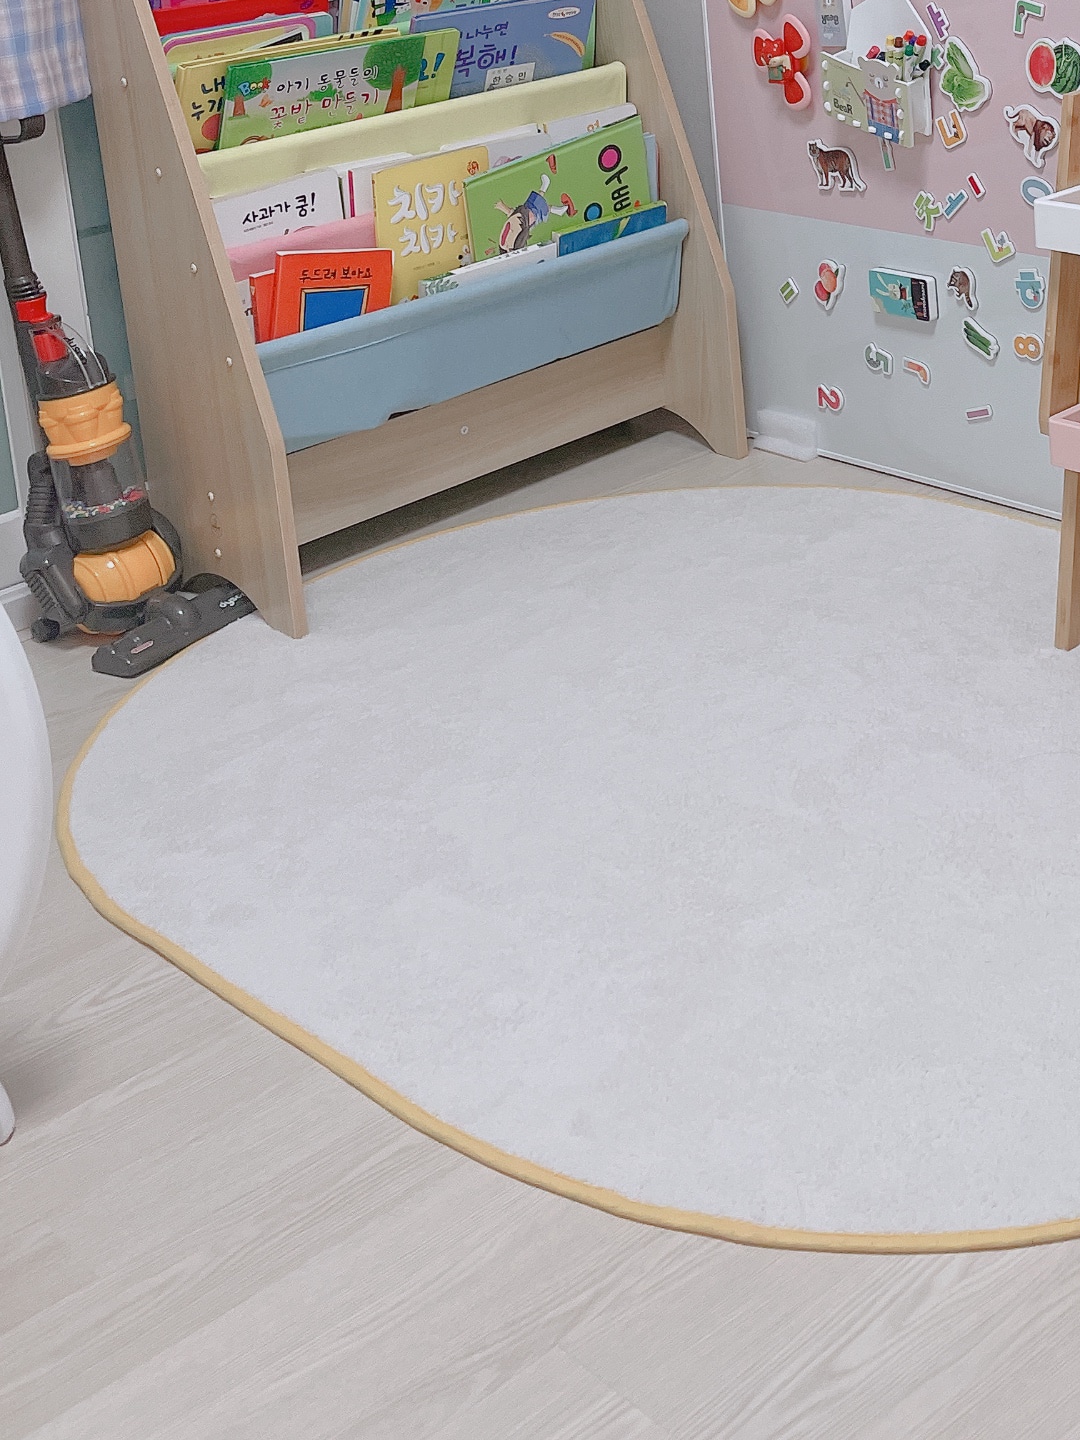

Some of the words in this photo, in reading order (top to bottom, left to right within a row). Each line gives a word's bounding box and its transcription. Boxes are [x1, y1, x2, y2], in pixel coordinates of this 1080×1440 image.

[277, 77, 309, 93] 아기
[318, 65, 379, 91] 동물들의
[270, 100, 312, 128] 꽃밭
[322, 88, 379, 117] 만들기
[242, 201, 291, 225] 사과가
[295, 192, 316, 218] 쿵!
[387, 180, 463, 224] 치카
[399, 223, 459, 257] 치카
[299, 268, 337, 283] 두드려
[340, 266, 373, 278] 보아요
